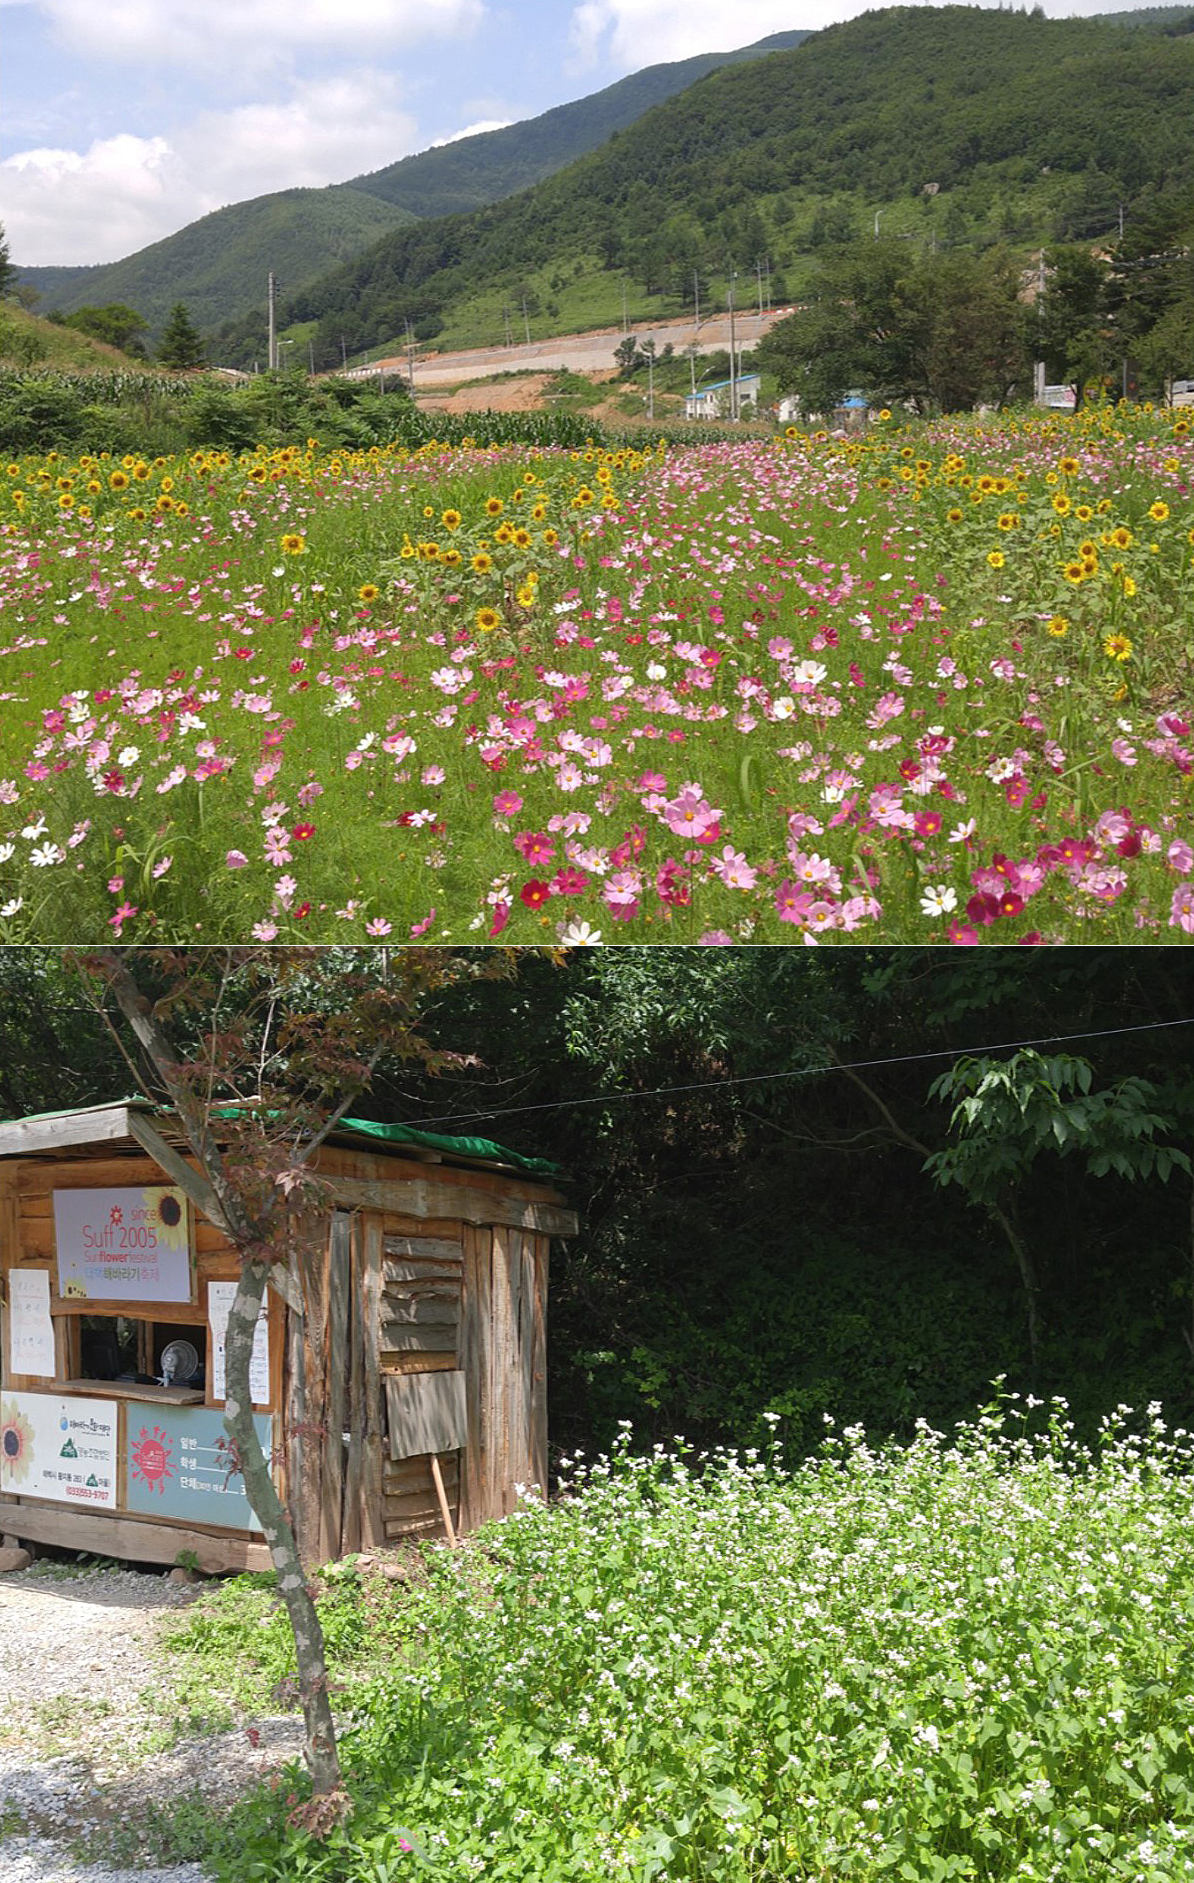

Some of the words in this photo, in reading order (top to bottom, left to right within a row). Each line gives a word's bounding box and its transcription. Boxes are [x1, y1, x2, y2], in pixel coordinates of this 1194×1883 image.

[131, 1209, 157, 1221] since
[82, 1223, 114, 1248] Suff
[119, 1226, 158, 1249] 2005
